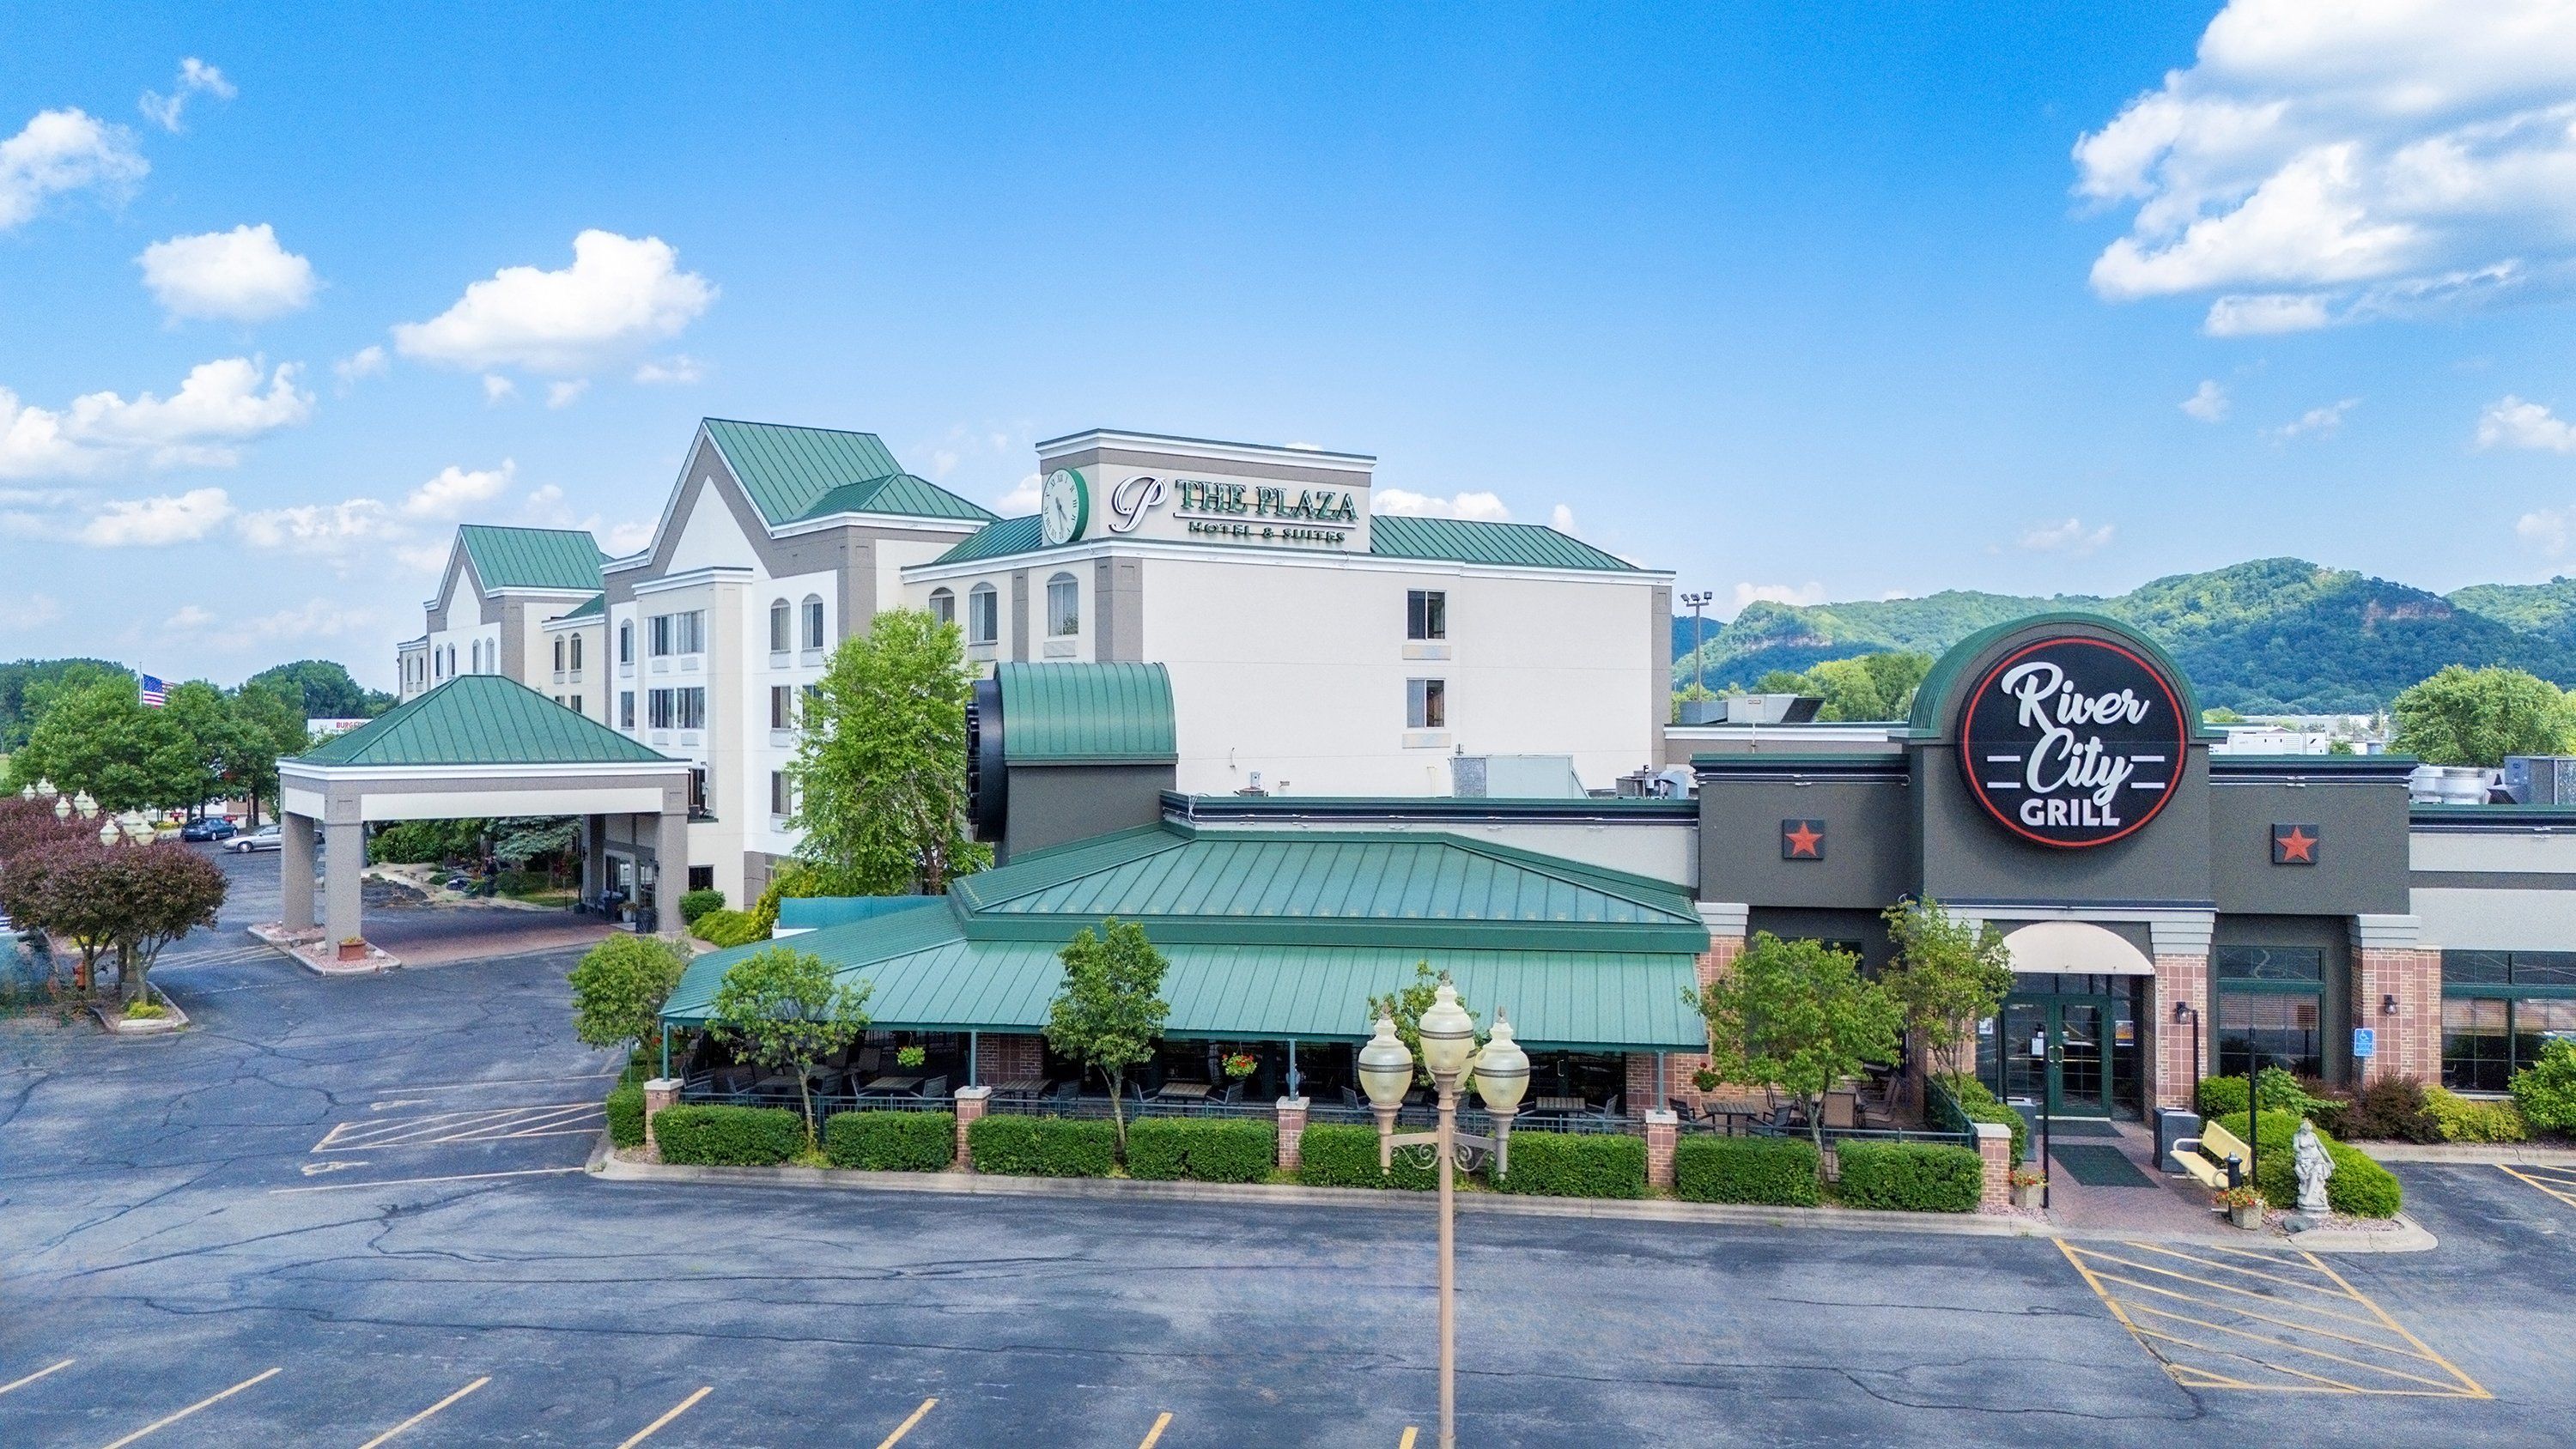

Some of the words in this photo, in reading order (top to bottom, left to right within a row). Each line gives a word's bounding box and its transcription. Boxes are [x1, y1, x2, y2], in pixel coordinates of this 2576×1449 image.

[1109, 476, 1168, 532] P
[1175, 478, 1249, 513] THE
[1255, 484, 1359, 521] PLAZA
[1188, 520, 1251, 537] HOTEL
[1262, 527, 1274, 538] &
[1283, 527, 1346, 543] SUITES
[2001, 661, 2150, 735] River
[2026, 727, 2134, 806] City
[2020, 798, 2120, 827] GRILL
